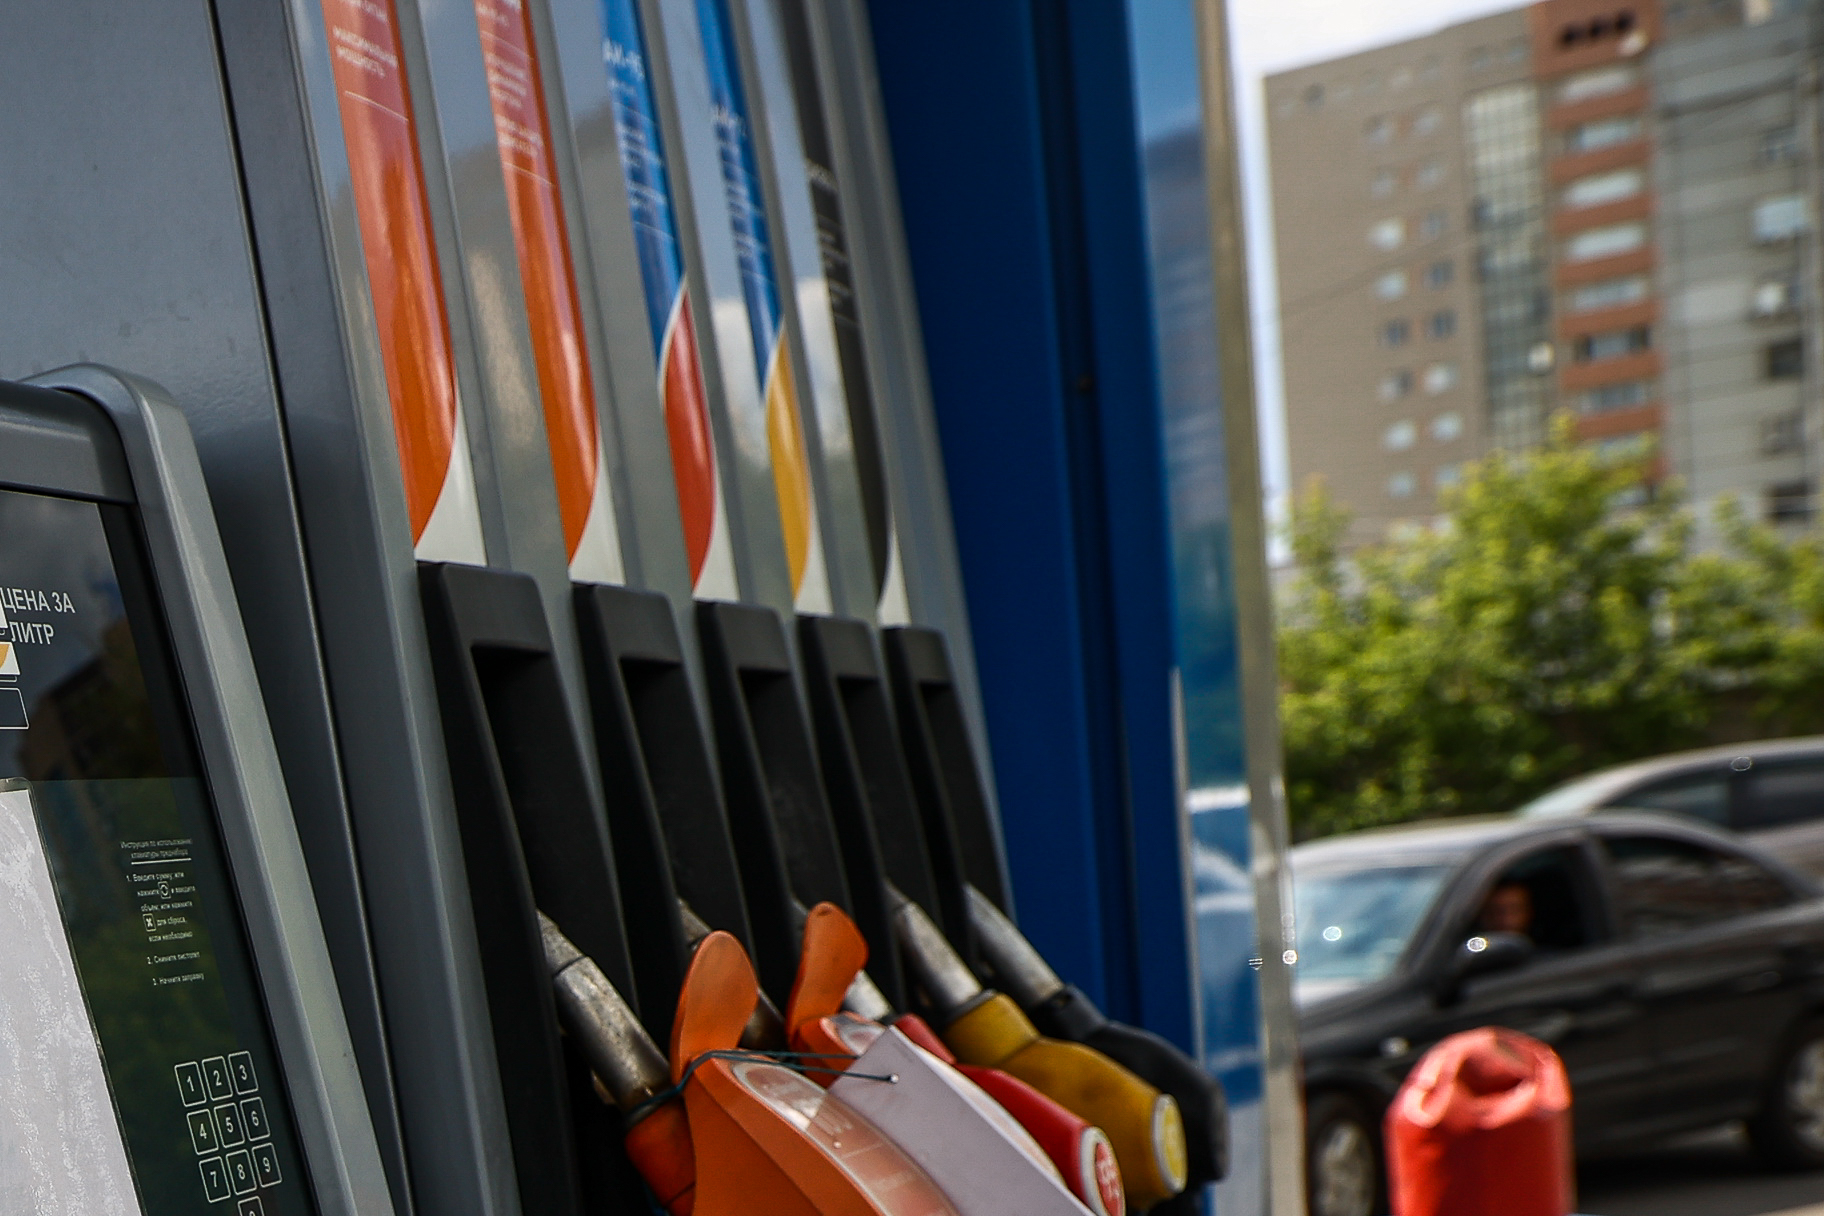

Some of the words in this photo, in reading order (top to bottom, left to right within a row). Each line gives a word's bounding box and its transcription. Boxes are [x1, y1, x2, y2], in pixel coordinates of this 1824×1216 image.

[0, 587, 51, 614] ЦЕНА
[51, 592, 76, 614] ЗА
[9, 622, 55, 645] ЛИТР
[187, 1075, 195, 1092] 1
[213, 1070, 223, 1087] 2
[239, 1064, 248, 1081] 3
[199, 1123, 208, 1140] 4
[226, 1117, 234, 1133] 5
[251, 1111, 260, 1127] 6
[210, 1171, 218, 1188] 7
[238, 1164, 246, 1180] 8
[262, 1157, 271, 1173] 9
